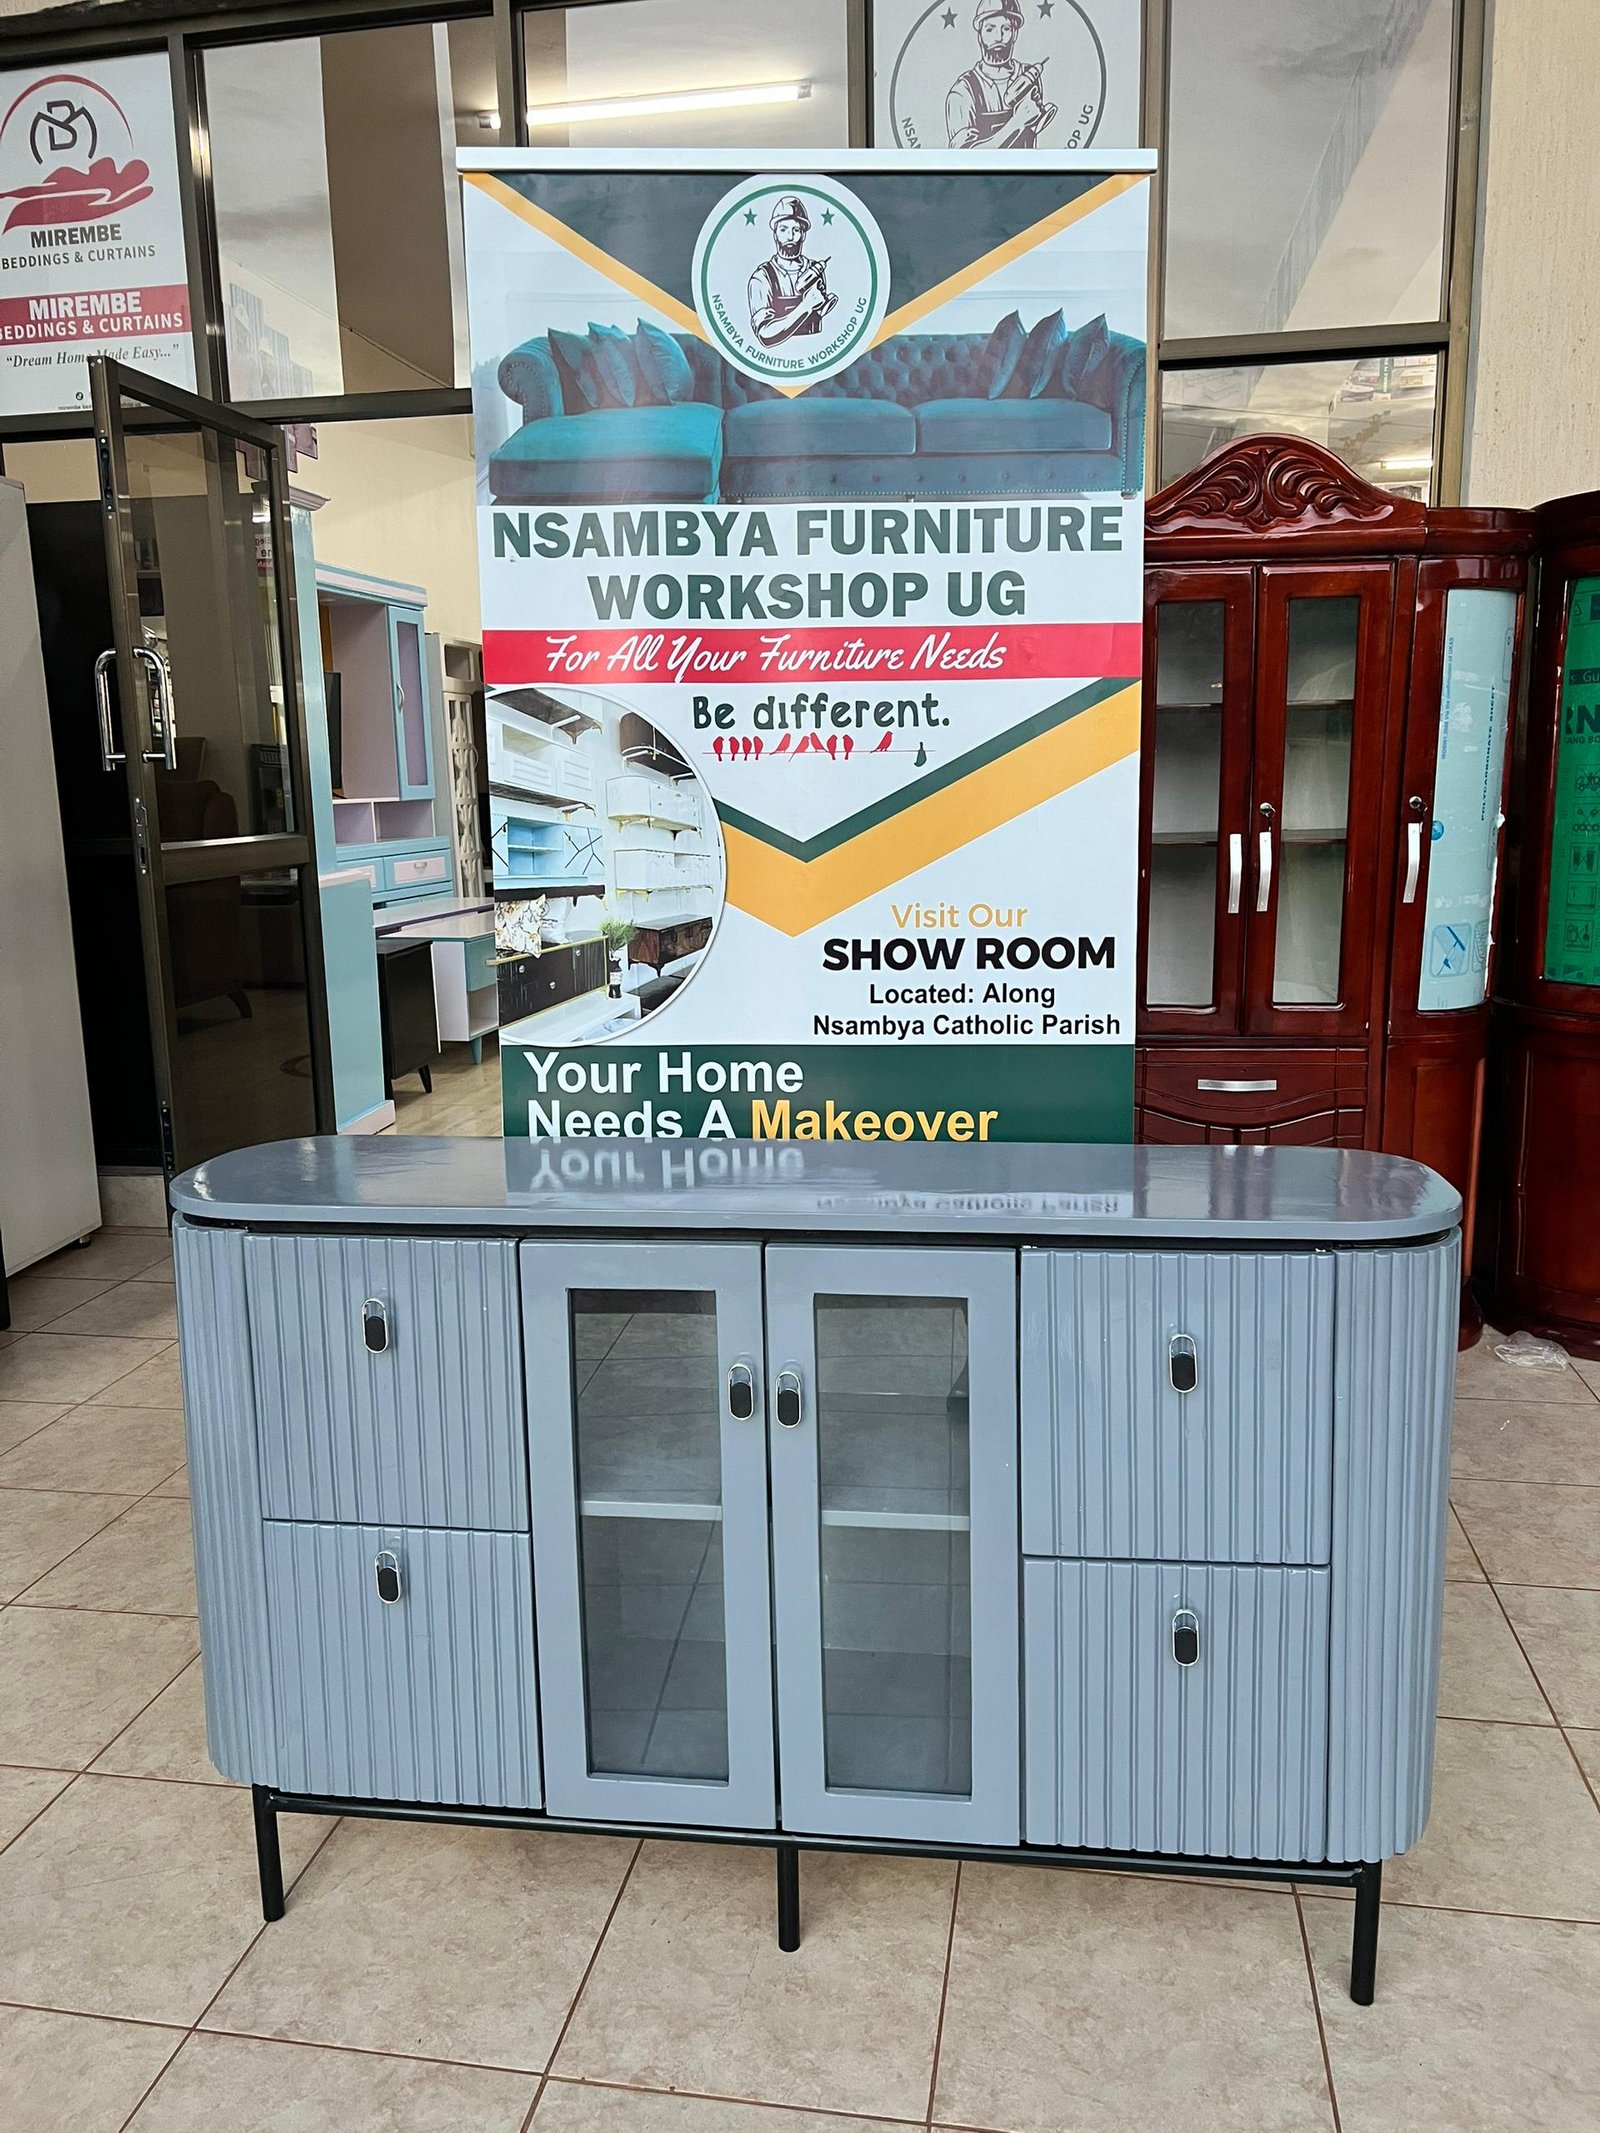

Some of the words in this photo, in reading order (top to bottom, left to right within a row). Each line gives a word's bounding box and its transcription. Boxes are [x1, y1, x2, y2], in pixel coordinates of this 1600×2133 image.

[1078, 104, 1094, 125] UG
[30, 224, 122, 248] MIREMBE
[2, 252, 70, 270] BEDDINGS
[74, 251, 84, 263] &
[88, 245, 156, 262] CURTAINS
[28, 291, 142, 321] MIREMBE
[82, 320, 94, 334] &
[99, 312, 184, 333] CURTAINS
[712, 294, 745, 348] NSAMBYA
[745, 345, 805, 369] FURNITURE
[808, 318, 859, 365] WORKSHOP
[855, 297, 867, 314] UG
[492, 510, 778, 558] NSAMBYA
[797, 506, 1123, 556] FURNITURE
[587, 571, 929, 620] WORKSHOP
[948, 570, 1025, 617] UG
[546, 634, 600, 672] For
[606, 634, 665, 672] All
[666, 635, 747, 684] Your
[760, 634, 904, 671] Furniture
[909, 632, 1007, 670] Needs
[693, 696, 735, 729] Be
[753, 693, 950, 730] different.
[891, 902, 960, 929] Visit
[968, 903, 1028, 928] Our
[822, 937, 966, 971] SHOW
[976, 936, 1115, 970] ROOM
[869, 983, 974, 1004] Located:
[982, 982, 1055, 1008] Along
[813, 1014, 925, 1040] Nsambya
[933, 1014, 1034, 1035] Catholic
[1043, 1014, 1120, 1035] Parish
[523, 1051, 642, 1094] Your
[658, 1051, 803, 1094] Home
[527, 1100, 683, 1140] Needs
[698, 1099, 737, 1138] A
[751, 1099, 999, 1141] Makeover
